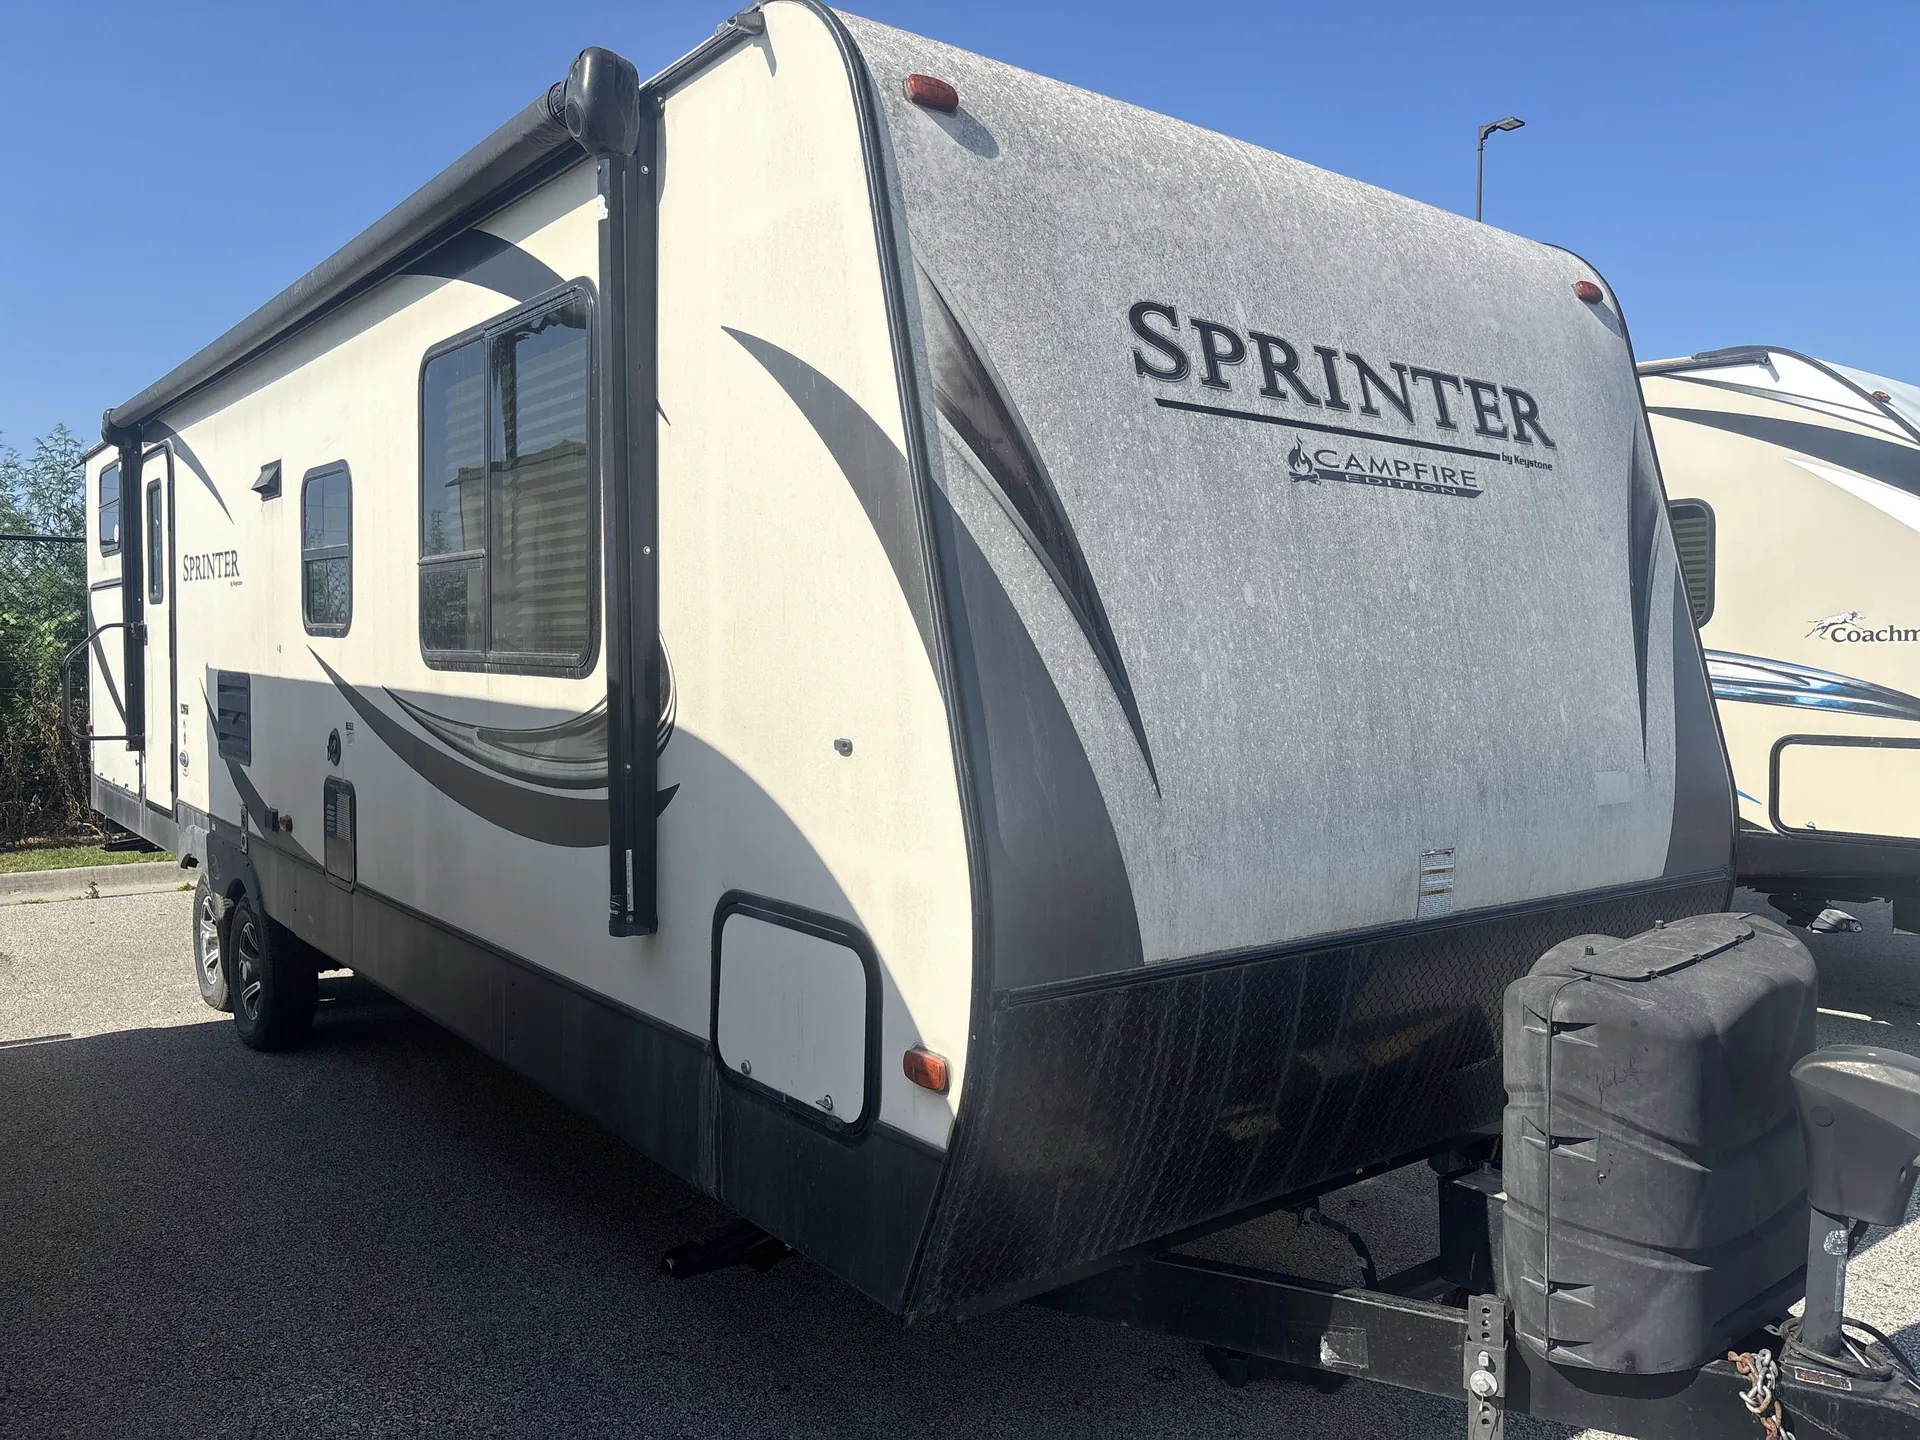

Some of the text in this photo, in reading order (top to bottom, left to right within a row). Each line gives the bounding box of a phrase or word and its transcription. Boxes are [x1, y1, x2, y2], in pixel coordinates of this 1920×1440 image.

[1128, 301, 1556, 449] SPRINTER
[1314, 450, 1478, 488] CAMPFIRE
[1502, 452, 1553, 471] by Keystone
[1345, 474, 1457, 495] EDITION
[183, 550, 240, 582] SPRINTER
